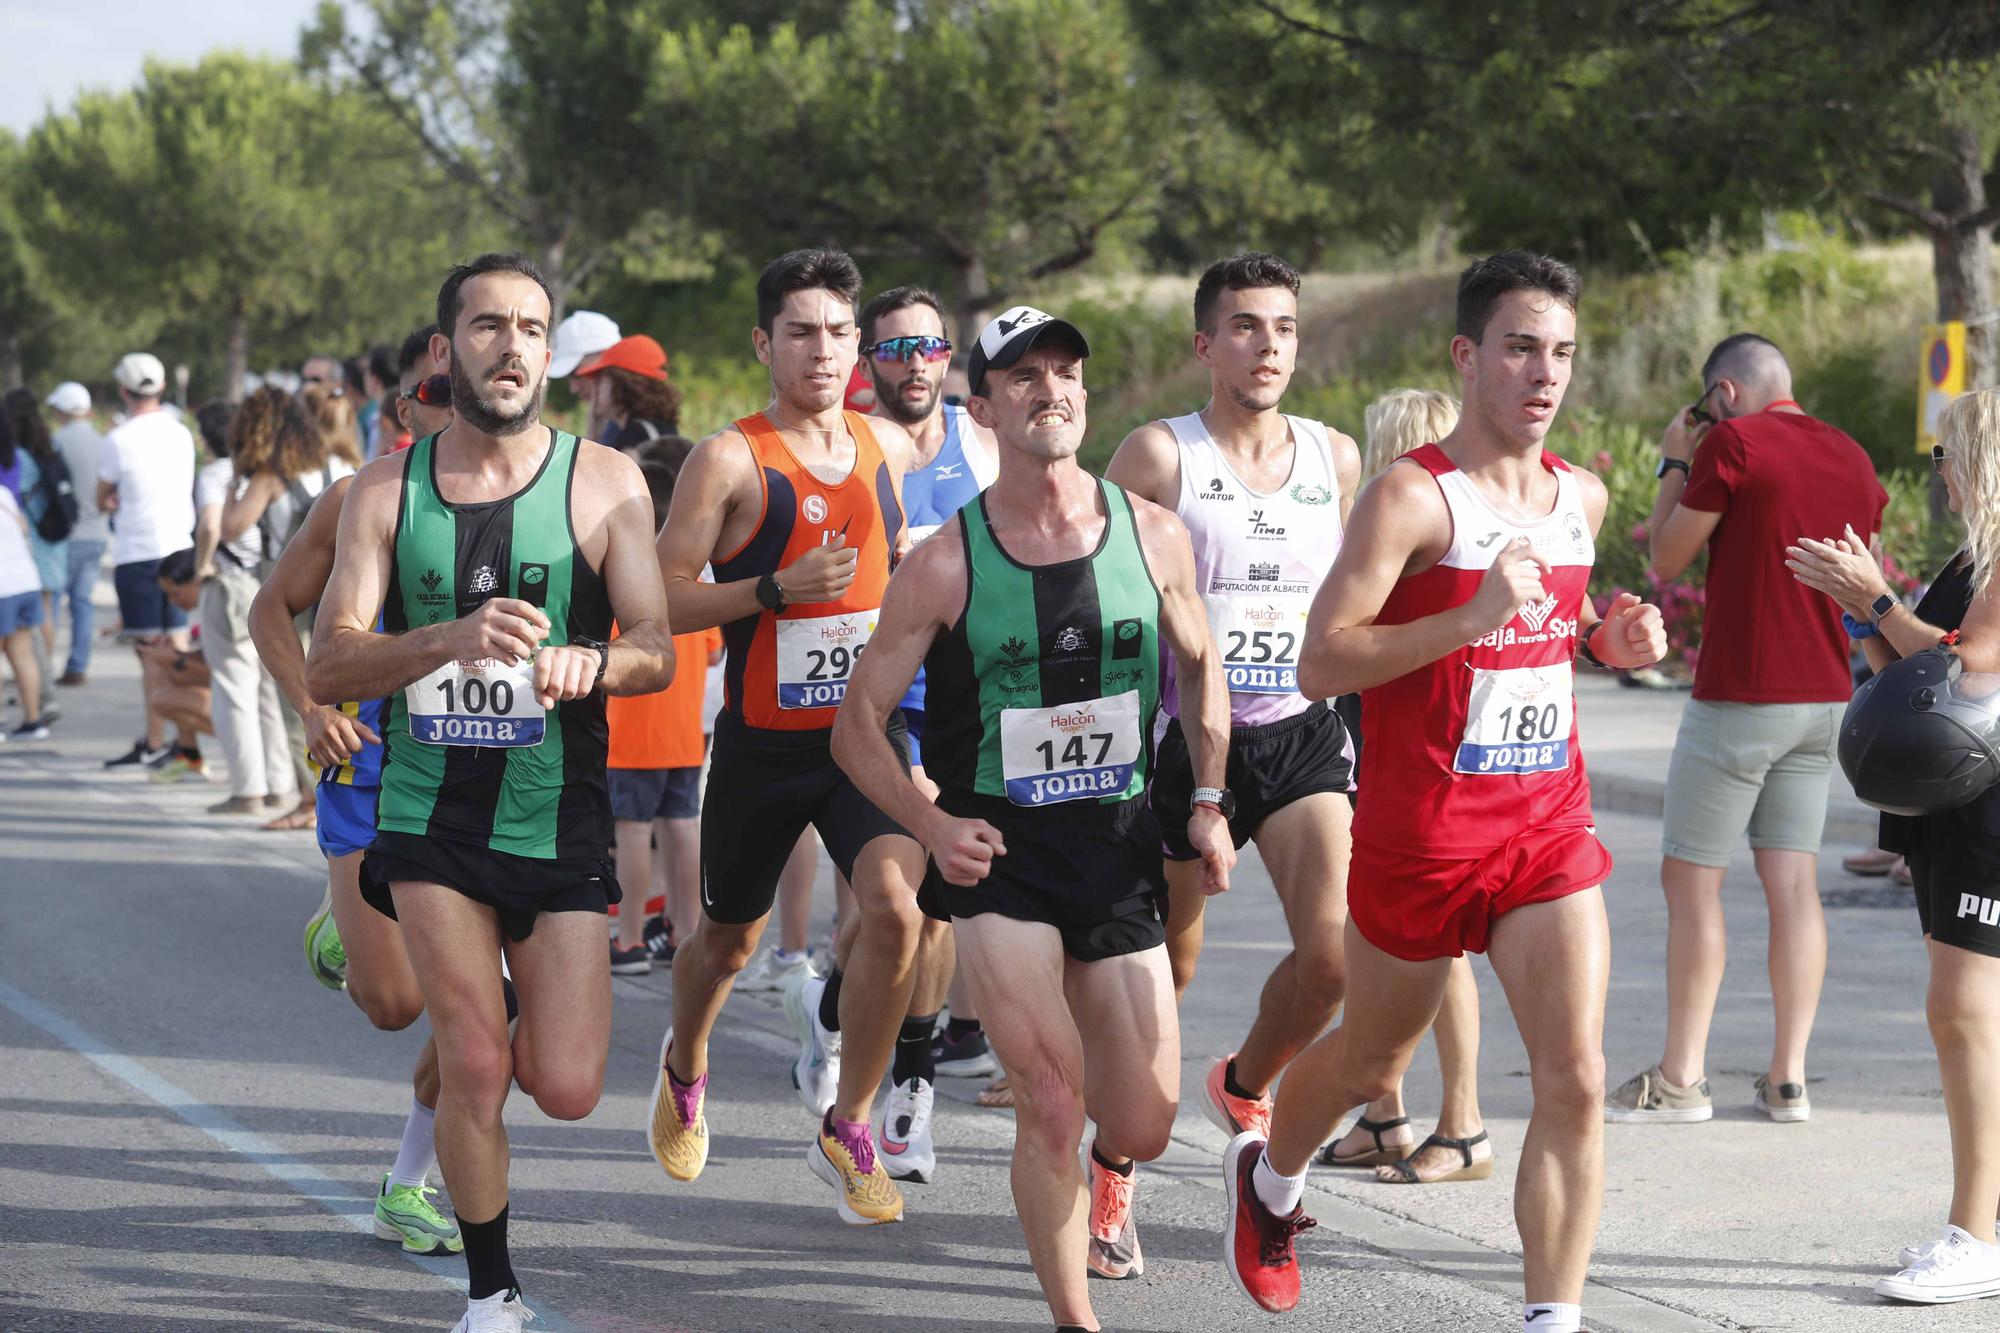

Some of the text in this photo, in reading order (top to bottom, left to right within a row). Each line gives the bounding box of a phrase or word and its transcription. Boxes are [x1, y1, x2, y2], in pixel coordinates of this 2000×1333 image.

[1200, 493, 1234, 501] VIATOR
[1212, 582, 1259, 592] DIPUTACIÓN
[1274, 585, 1309, 593] ALBACETE
[1224, 630, 1296, 664] 252
[437, 678, 514, 716] 100
[1499, 703, 1558, 742] 180
[1035, 732, 1114, 772] 147
[1957, 892, 2000, 926] PU
